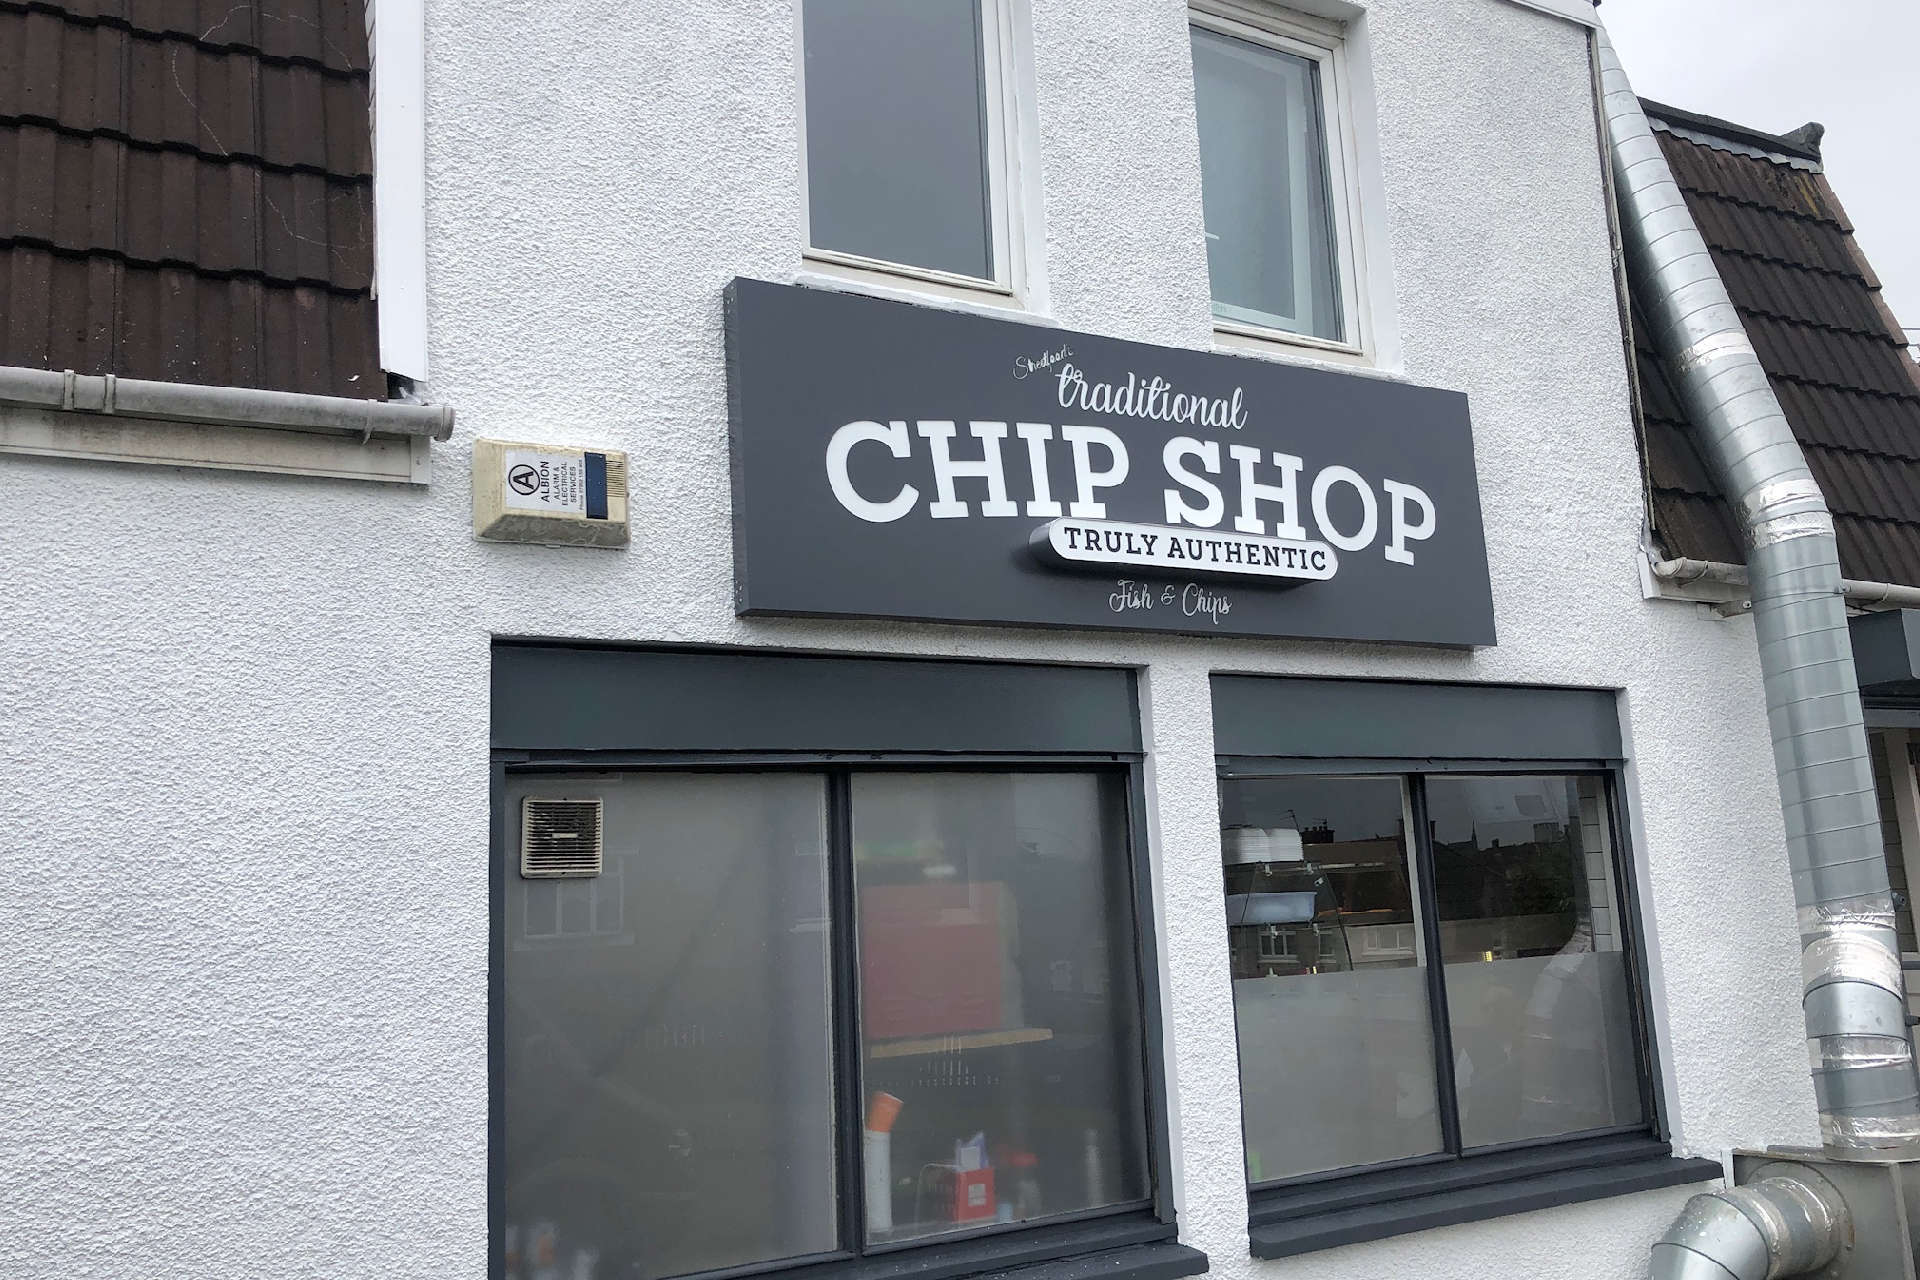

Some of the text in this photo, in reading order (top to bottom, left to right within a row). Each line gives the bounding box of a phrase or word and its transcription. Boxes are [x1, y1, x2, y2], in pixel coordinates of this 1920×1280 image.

[1054, 363, 1249, 430] traditional
[540, 461, 550, 503] ALBION
[553, 473, 561, 501] ALARM
[561, 461, 569, 506] ELECTRICAL
[825, 420, 1437, 566] CHIP SHOP
[1064, 526, 1327, 571] TRULY AUTHENTIC
[1108, 579, 1233, 626] Fish & Chips
